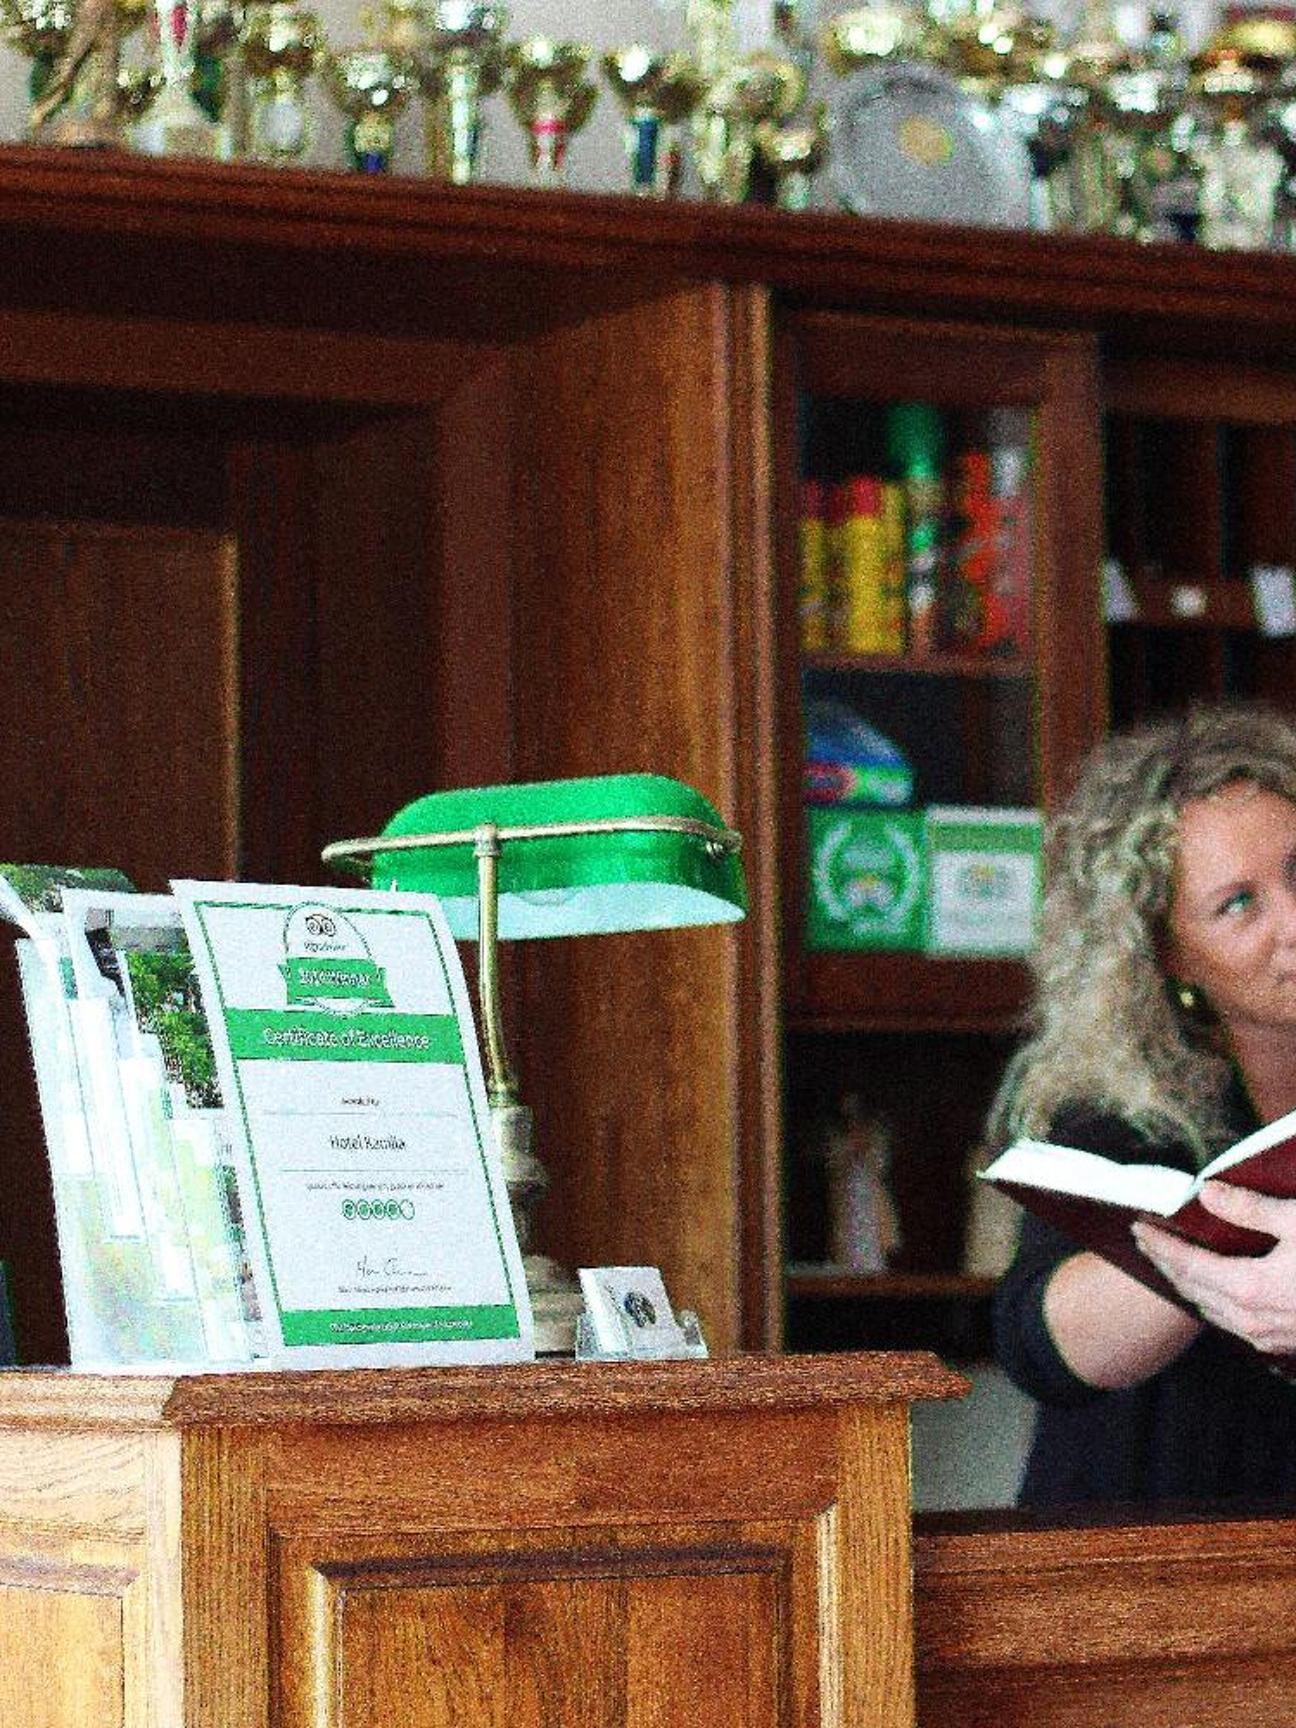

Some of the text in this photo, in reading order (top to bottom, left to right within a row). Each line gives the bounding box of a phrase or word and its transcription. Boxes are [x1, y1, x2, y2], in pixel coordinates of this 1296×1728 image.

[263, 1027, 431, 1049] Certificate of Excellence
[329, 1134, 363, 1150] Hotel
